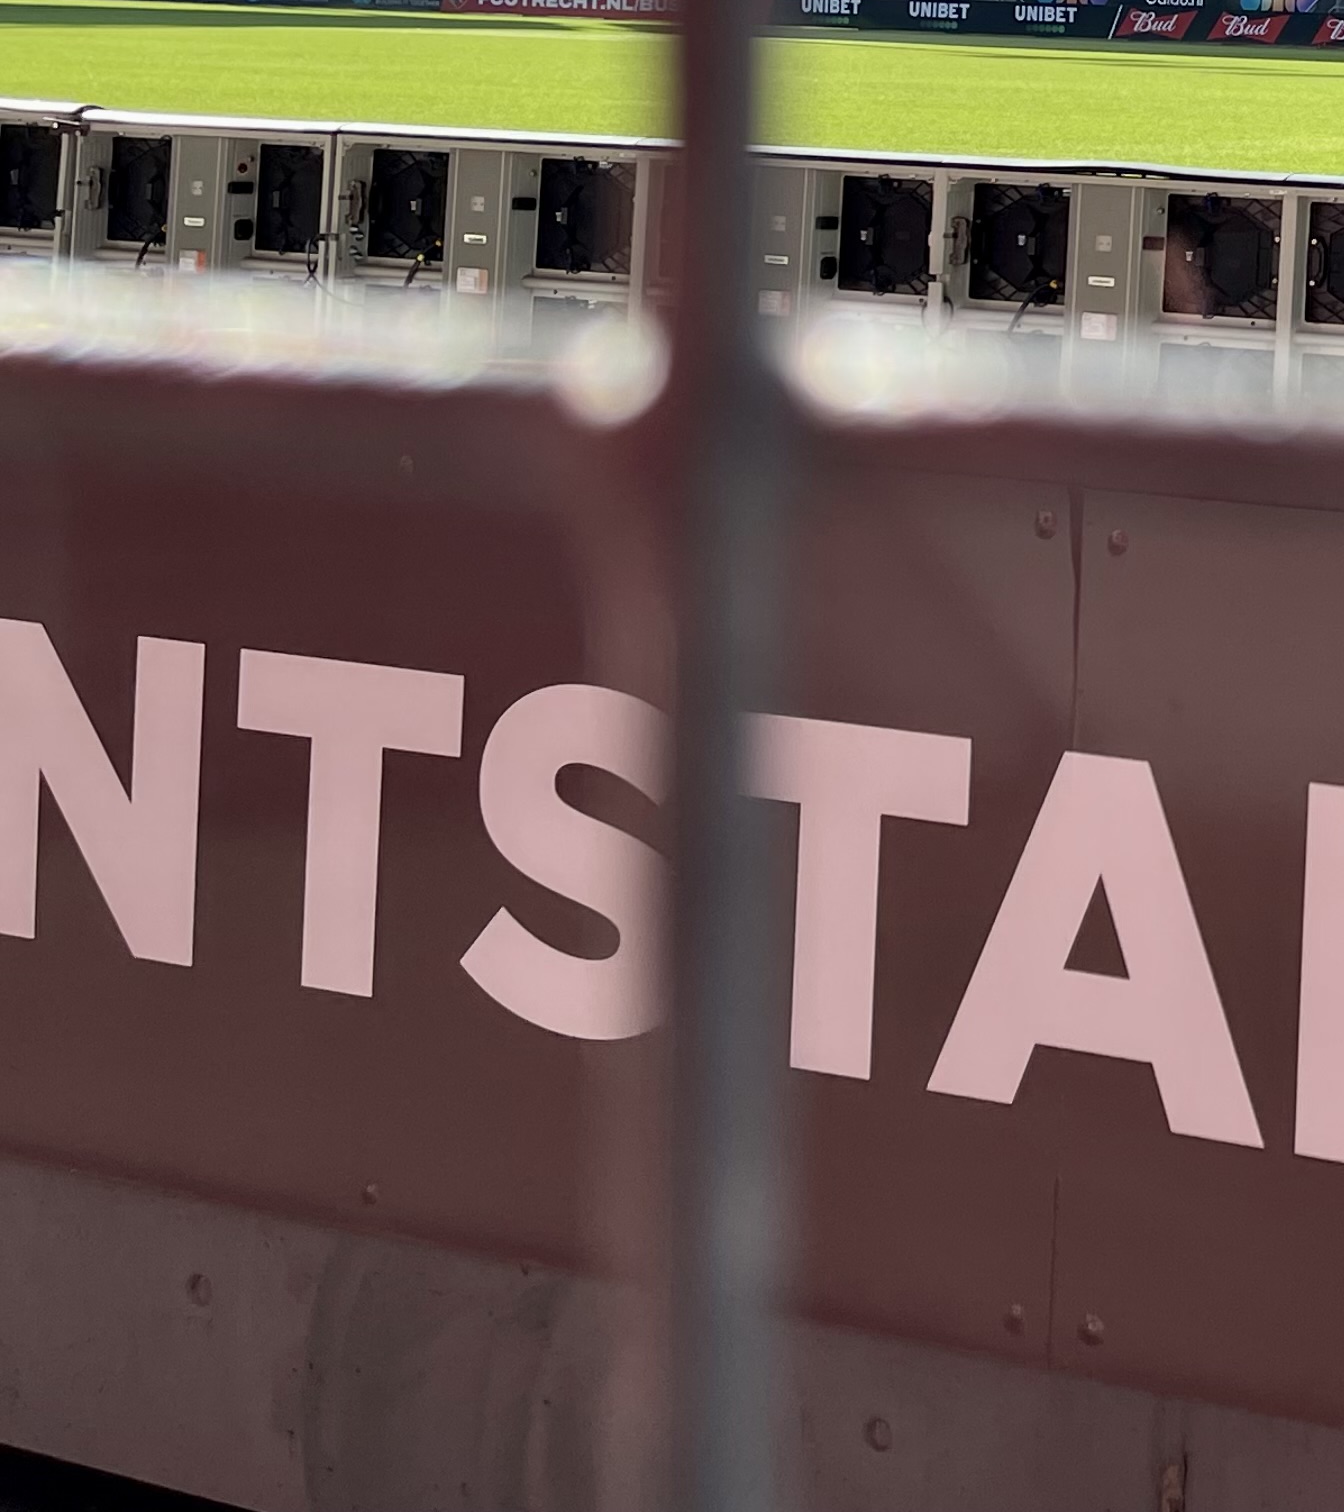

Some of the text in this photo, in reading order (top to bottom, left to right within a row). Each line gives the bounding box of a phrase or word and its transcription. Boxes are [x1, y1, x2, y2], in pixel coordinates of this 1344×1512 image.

[909, 1, 970, 19] UNIBET
[1015, 5, 1078, 23] UNIBET
[1130, 10, 1179, 33] Bud
[1222, 14, 1271, 36] Bud
